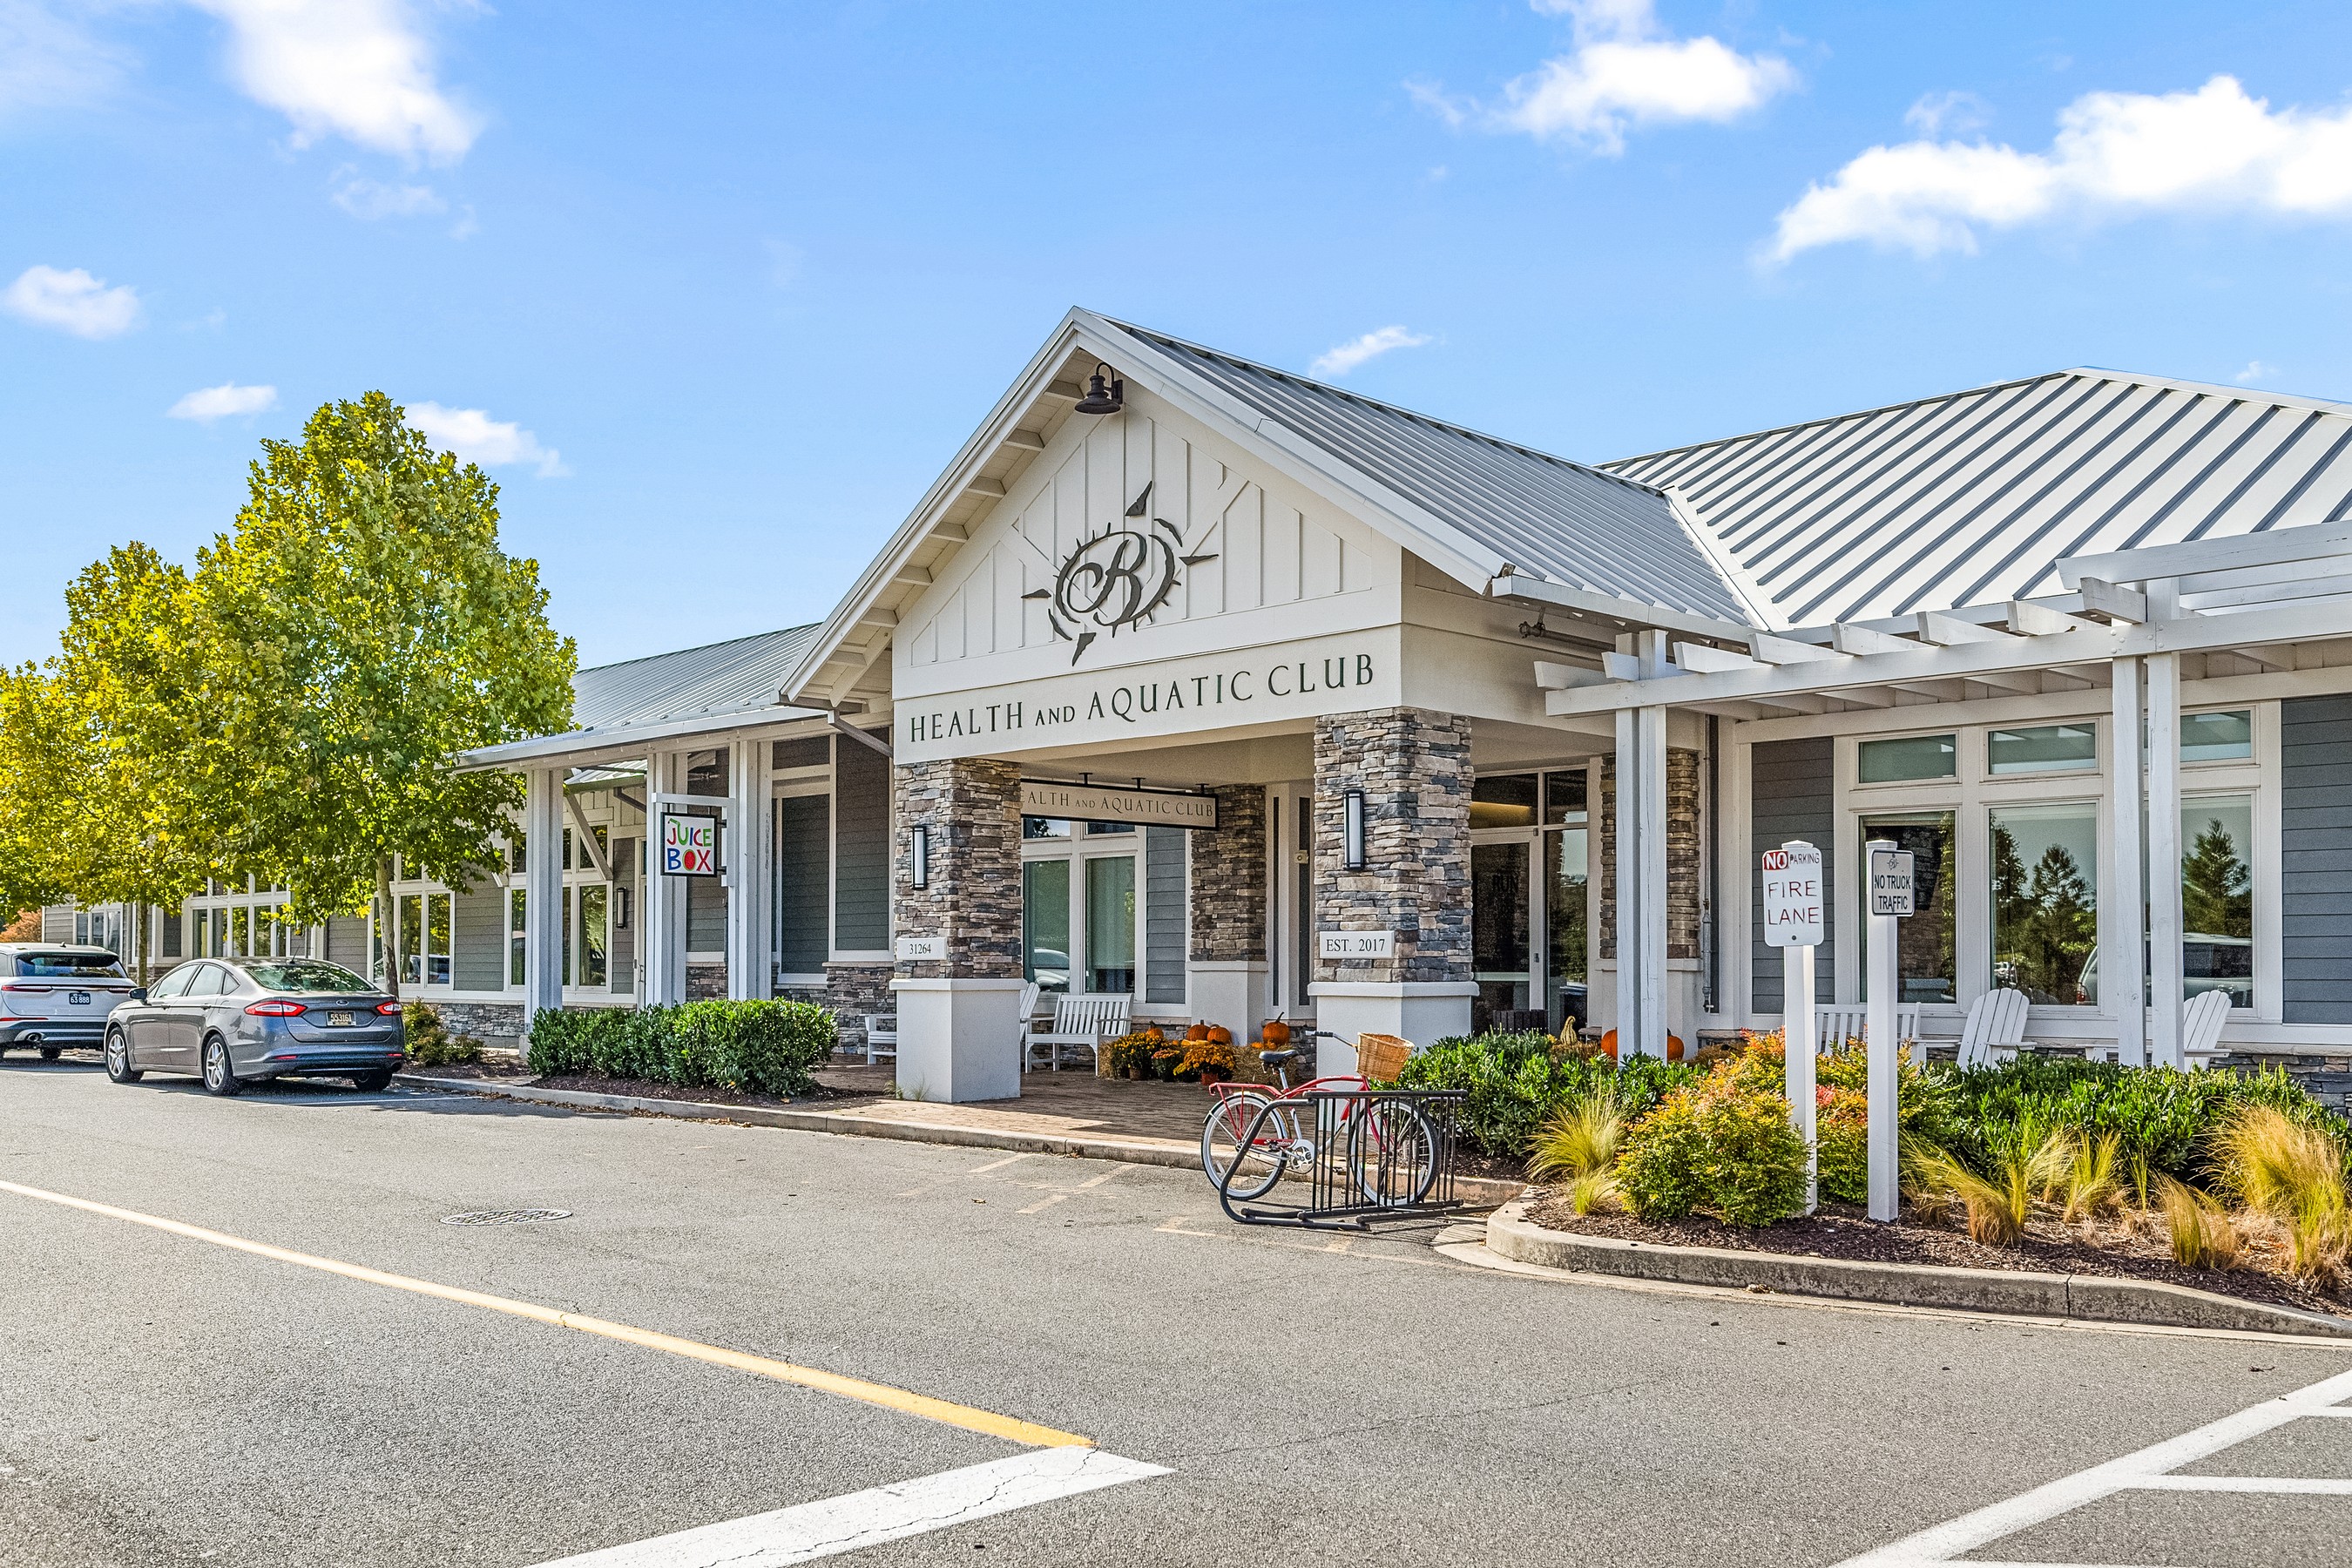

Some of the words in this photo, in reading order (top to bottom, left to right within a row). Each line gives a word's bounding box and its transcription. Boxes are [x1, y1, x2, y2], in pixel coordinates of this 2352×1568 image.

[910, 701, 1023, 742] HEALTH
[1035, 706, 1076, 727] AND
[1087, 671, 1253, 723] AQUATIC
[1267, 653, 1373, 696] CLUB
[1020, 789, 1069, 807] EALTH
[1101, 796, 1171, 814] AQUATIC
[1176, 801, 1213, 817] CLUB
[666, 821, 713, 847] JUICE
[667, 848, 713, 872] BOX
[1766, 852, 1788, 869] NO
[1789, 853, 1820, 864] PARKING
[1767, 880, 1817, 898] FIRE
[1874, 875, 1885, 889] NO
[1886, 875, 1911, 889] TRUCK
[1878, 896, 1908, 910] TRAFFIC
[1767, 907, 1820, 925] LANE
[909, 943, 931, 955] 31264
[1326, 938, 1352, 952] EST.
[1359, 938, 1385, 952] 2017
